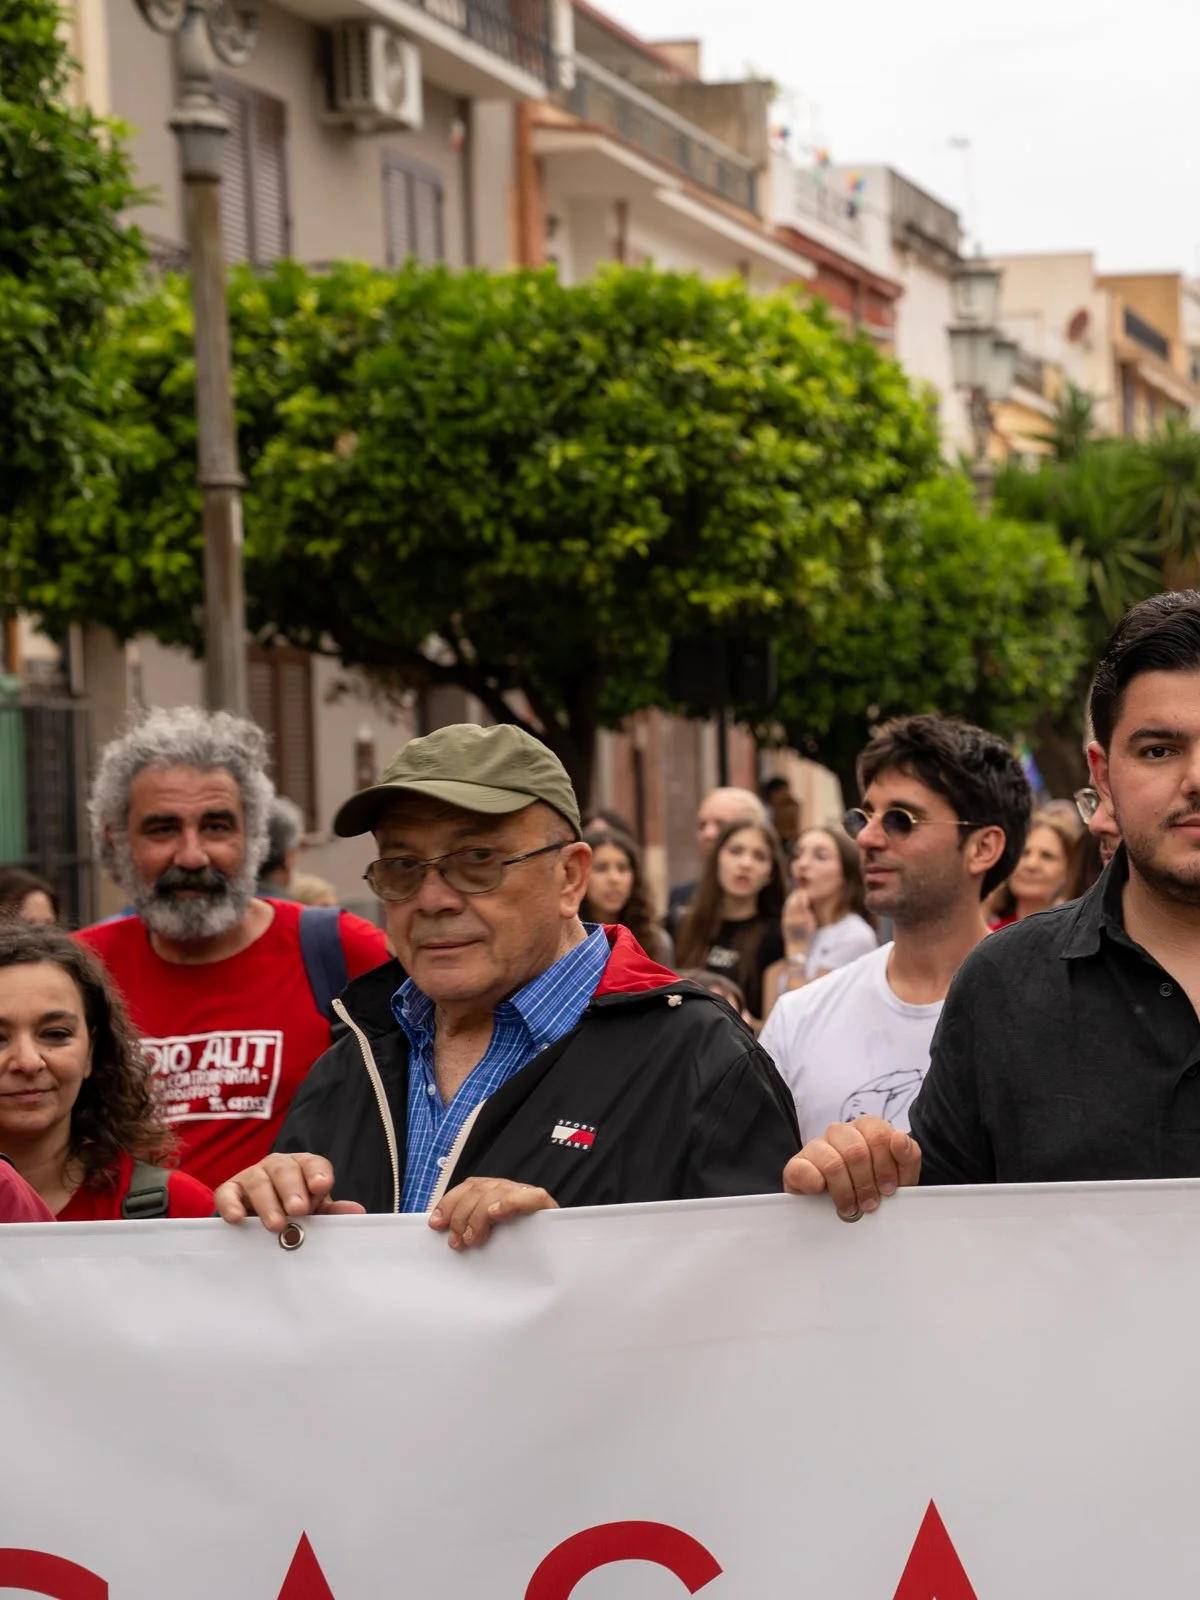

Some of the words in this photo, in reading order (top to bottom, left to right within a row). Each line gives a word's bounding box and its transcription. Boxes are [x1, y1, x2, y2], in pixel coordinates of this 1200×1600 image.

[139, 1043, 192, 1075] DIO
[197, 1036, 276, 1070] AUT
[558, 1119, 595, 1132] SPORT
[551, 1138, 589, 1150] JEANS
